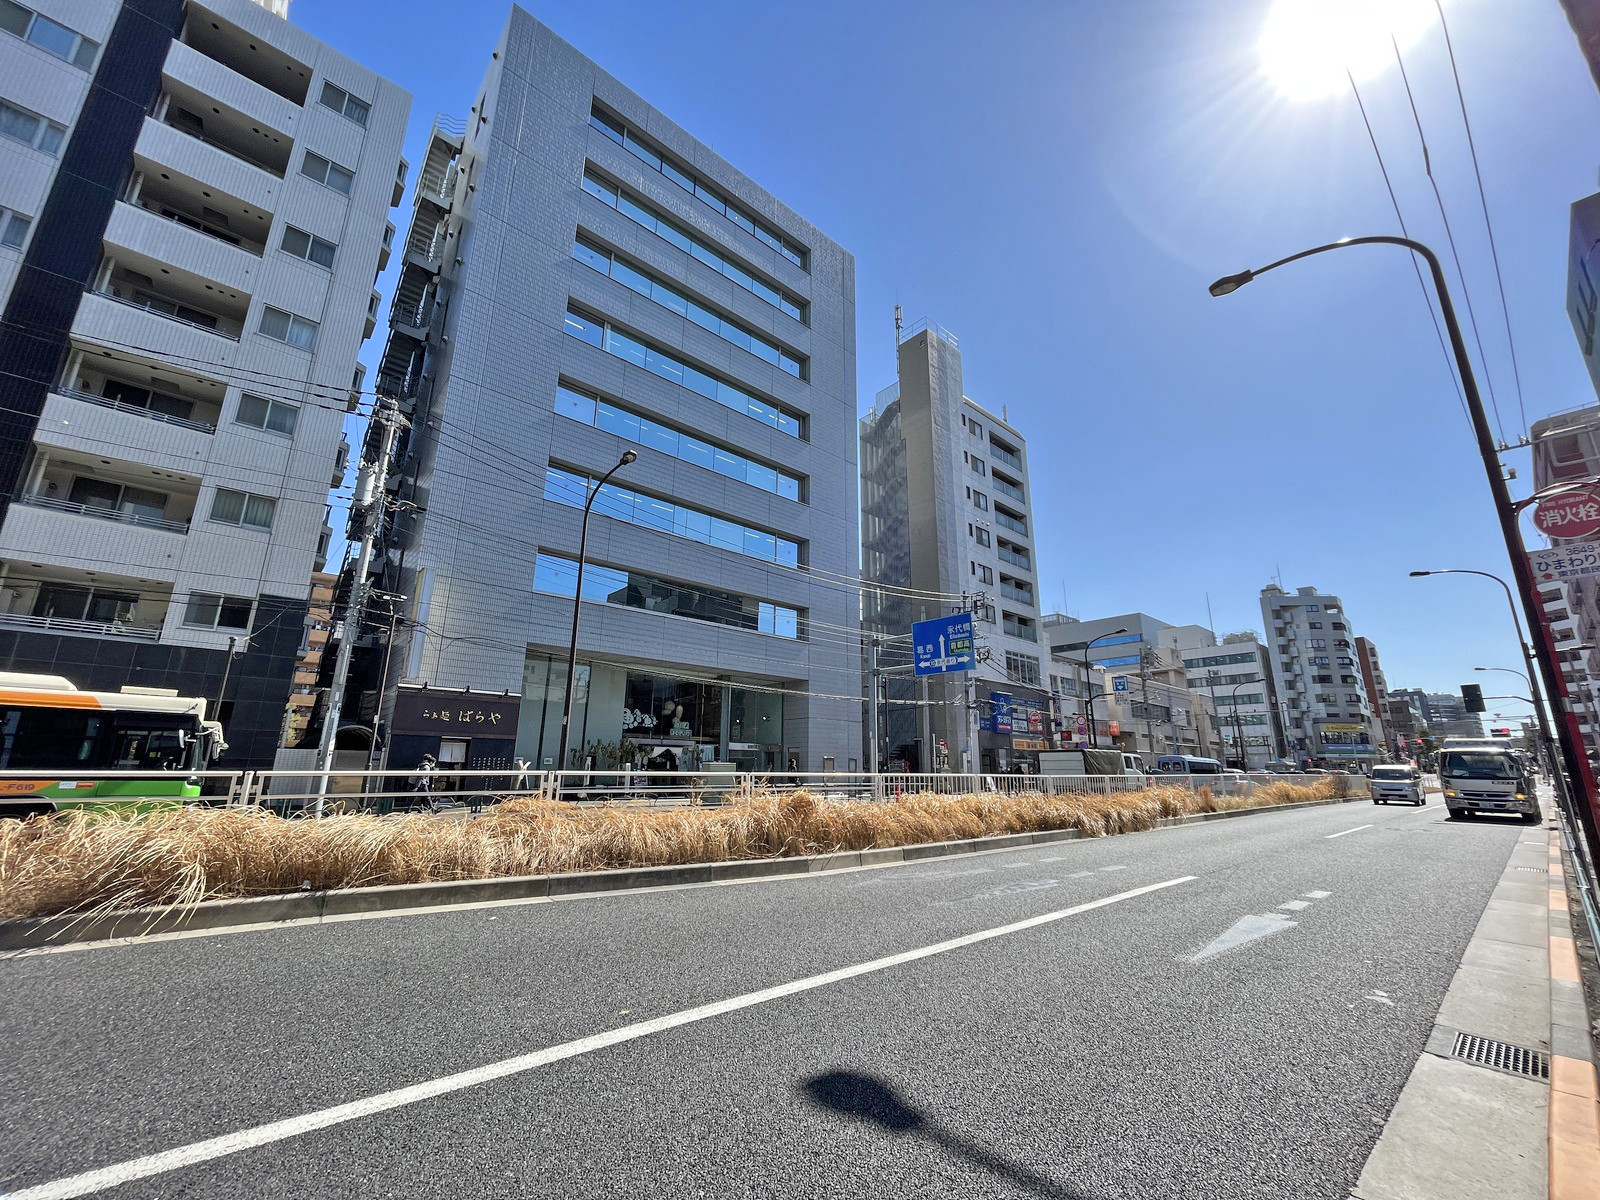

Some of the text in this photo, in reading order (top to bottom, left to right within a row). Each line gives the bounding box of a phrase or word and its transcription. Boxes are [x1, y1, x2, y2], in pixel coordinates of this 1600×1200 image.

[1539, 502, 1600, 528] 消火栓
[1566, 544, 1600, 556] 3649-
[459, 710, 501, 725] ばらや
